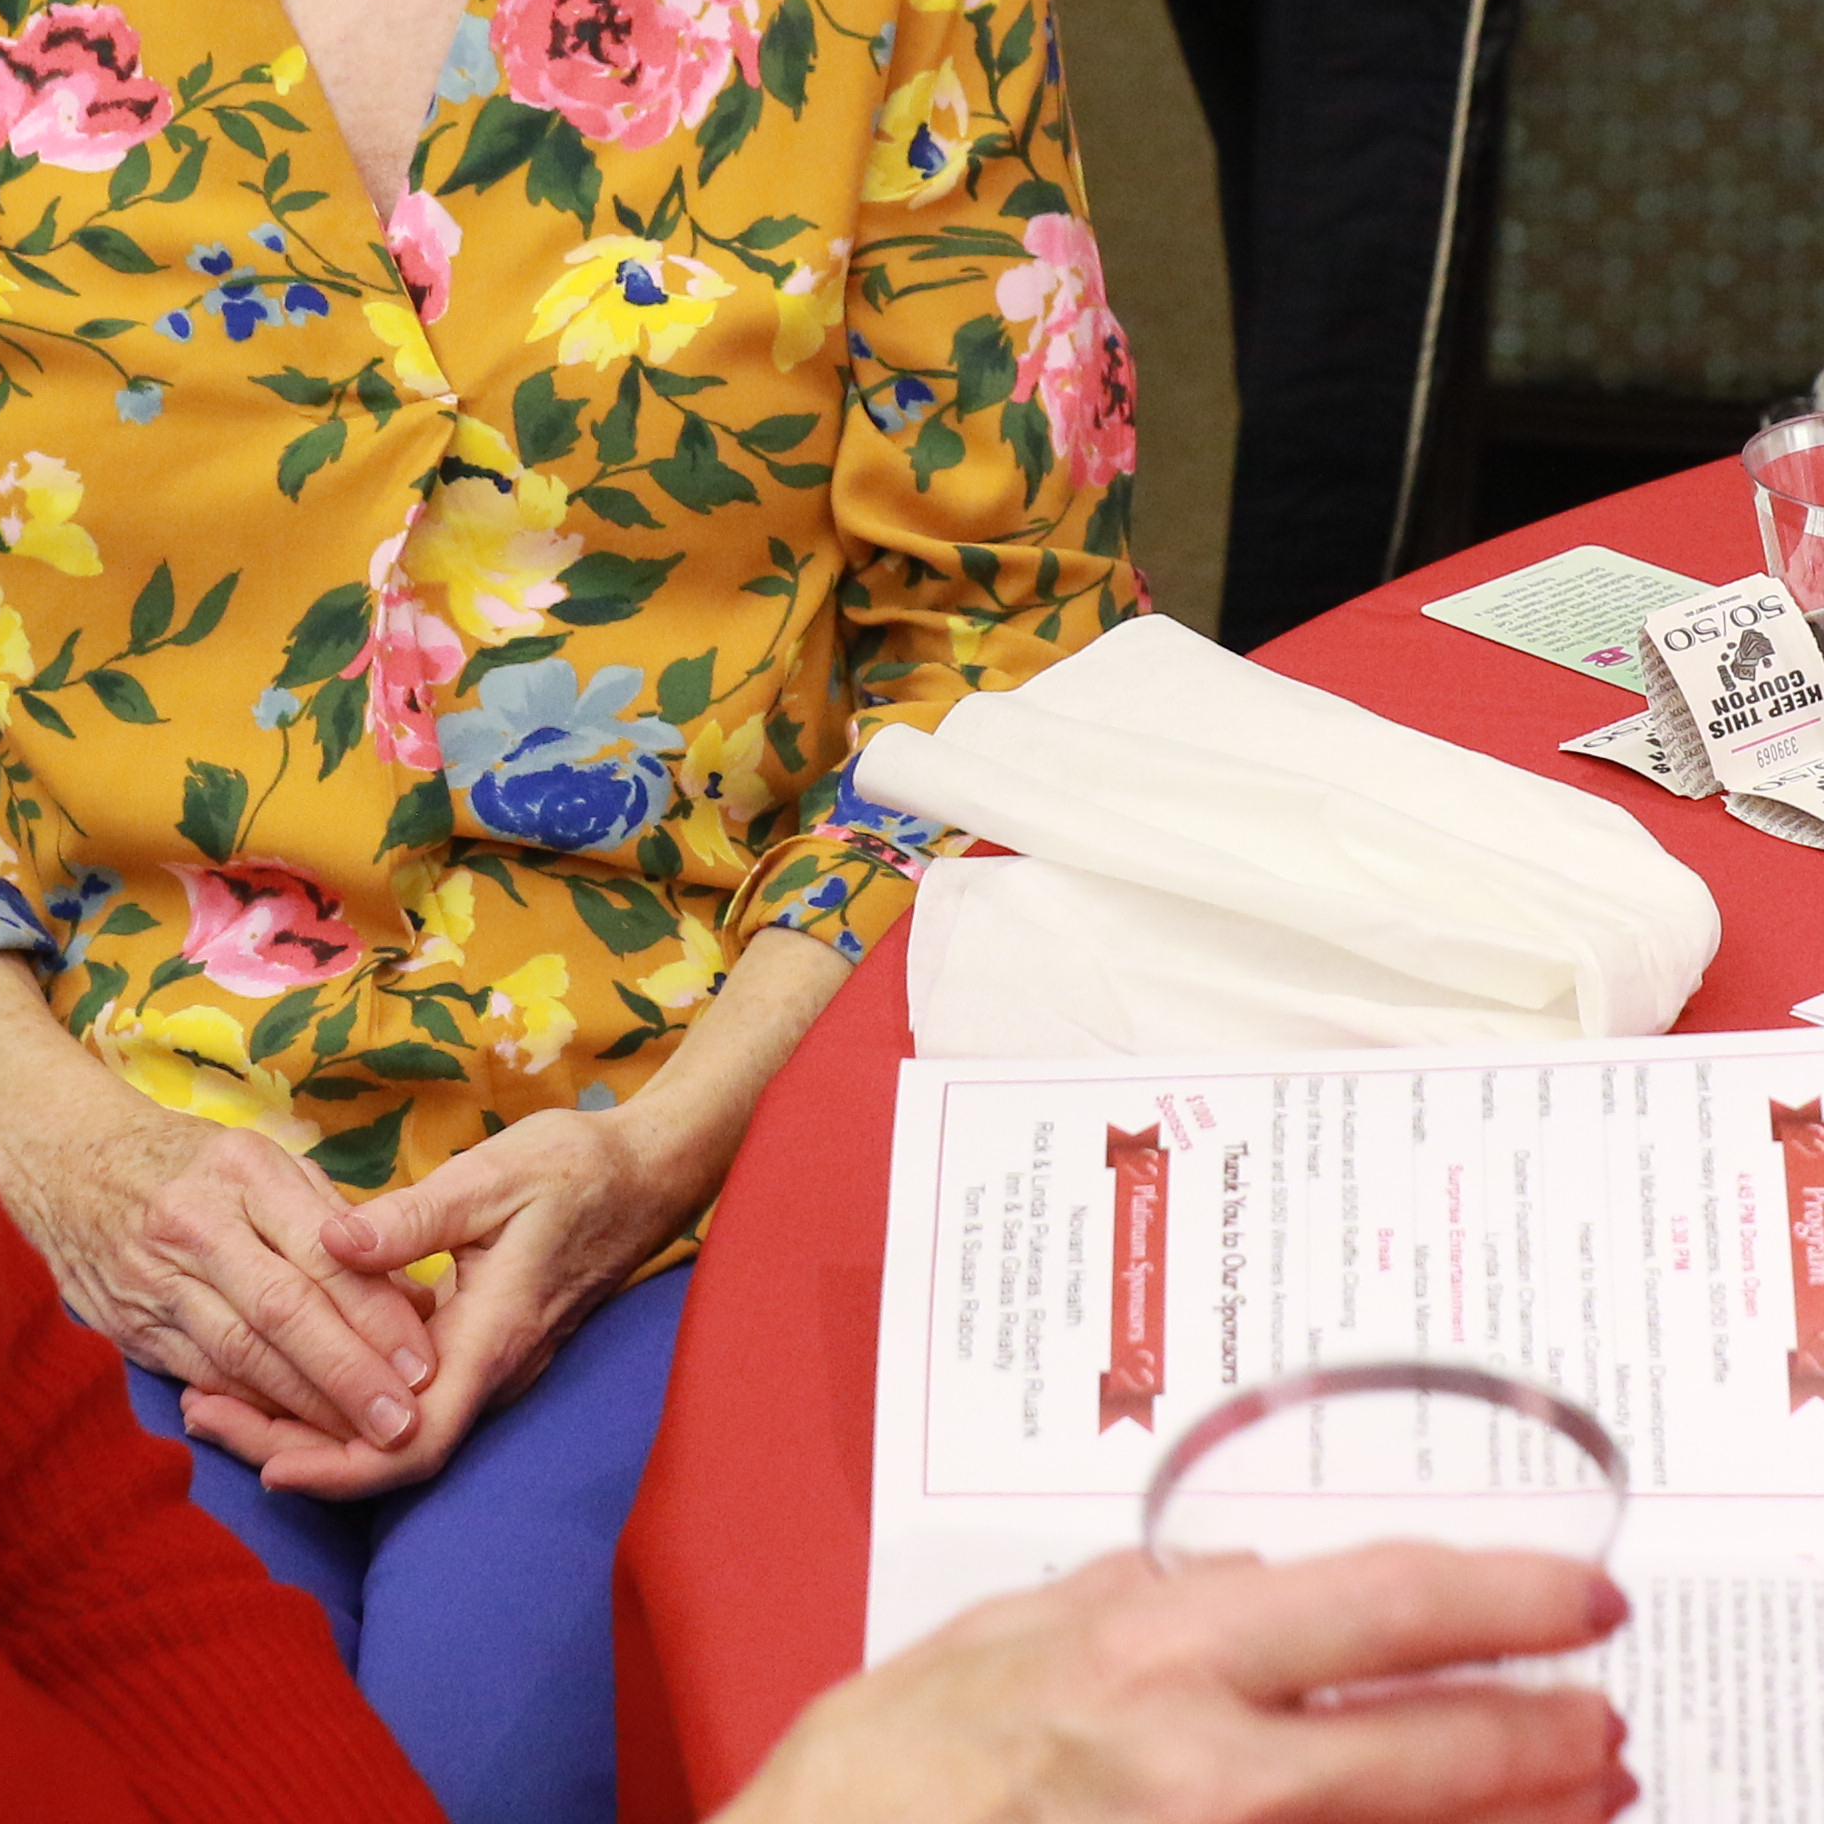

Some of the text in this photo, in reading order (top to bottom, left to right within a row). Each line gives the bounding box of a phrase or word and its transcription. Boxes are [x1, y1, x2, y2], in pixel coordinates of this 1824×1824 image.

[1664, 595, 1785, 652] 50/50
[1708, 684, 1824, 740] KEEP THIS
[1711, 670, 1806, 717] COUPON
[1756, 736, 1800, 768] 339069
[1032, 1121, 1054, 1152] Rick
[1272, 1112, 1288, 1154] Auction
[1342, 1109, 1357, 1150] Auction
[1032, 1157, 1052, 1170] &
[1272, 1160, 1287, 1182] and
[1306, 1144, 1322, 1177] Heart
[1342, 1157, 1357, 1179] and
[1697, 1147, 1715, 1188] Heavy
[1029, 1176, 1051, 1217] Linda
[1271, 1188, 1287, 1223] 50/50
[1342, 1184, 1357, 1220] 50/50
[1065, 1205, 1087, 1327] Novant Health
[1119, 1184, 1156, 1345] Platinum Sponsors
[1214, 1141, 1250, 1385] Thank You to Our Sponsors
[1271, 1228, 1287, 1284] Winners
[1342, 1225, 1358, 1267] Raffle
[1377, 1228, 1393, 1271] Break
[1447, 1164, 1467, 1343] Surprise Entertainment
[1483, 1233, 1501, 1277] Lynda
[1516, 1201, 1533, 1281] Foundation
[1672, 1217, 1691, 1271] 5:30 PM
[1737, 1173, 1760, 1317] 4:45 PM Doors Open
[957, 1184, 986, 1360] Tom & Susan Rabon
[994, 1172, 1025, 1371] Inn & Sea Glass Realty
[1580, 1222, 1599, 1330] Heart to Heart
[1339, 1272, 1358, 1327] Closing
[1518, 1287, 1536, 1364] Chairman
[1644, 1267, 1664, 1357] Foundation
[1709, 1282, 1727, 1326] 50/50
[1024, 1308, 1046, 1370] Robert
[1711, 1333, 1730, 1383] Raffle
[1022, 1378, 1044, 1438] Ruark
[1614, 1363, 1632, 1426] Melody
[1647, 1364, 1668, 1485] Development
